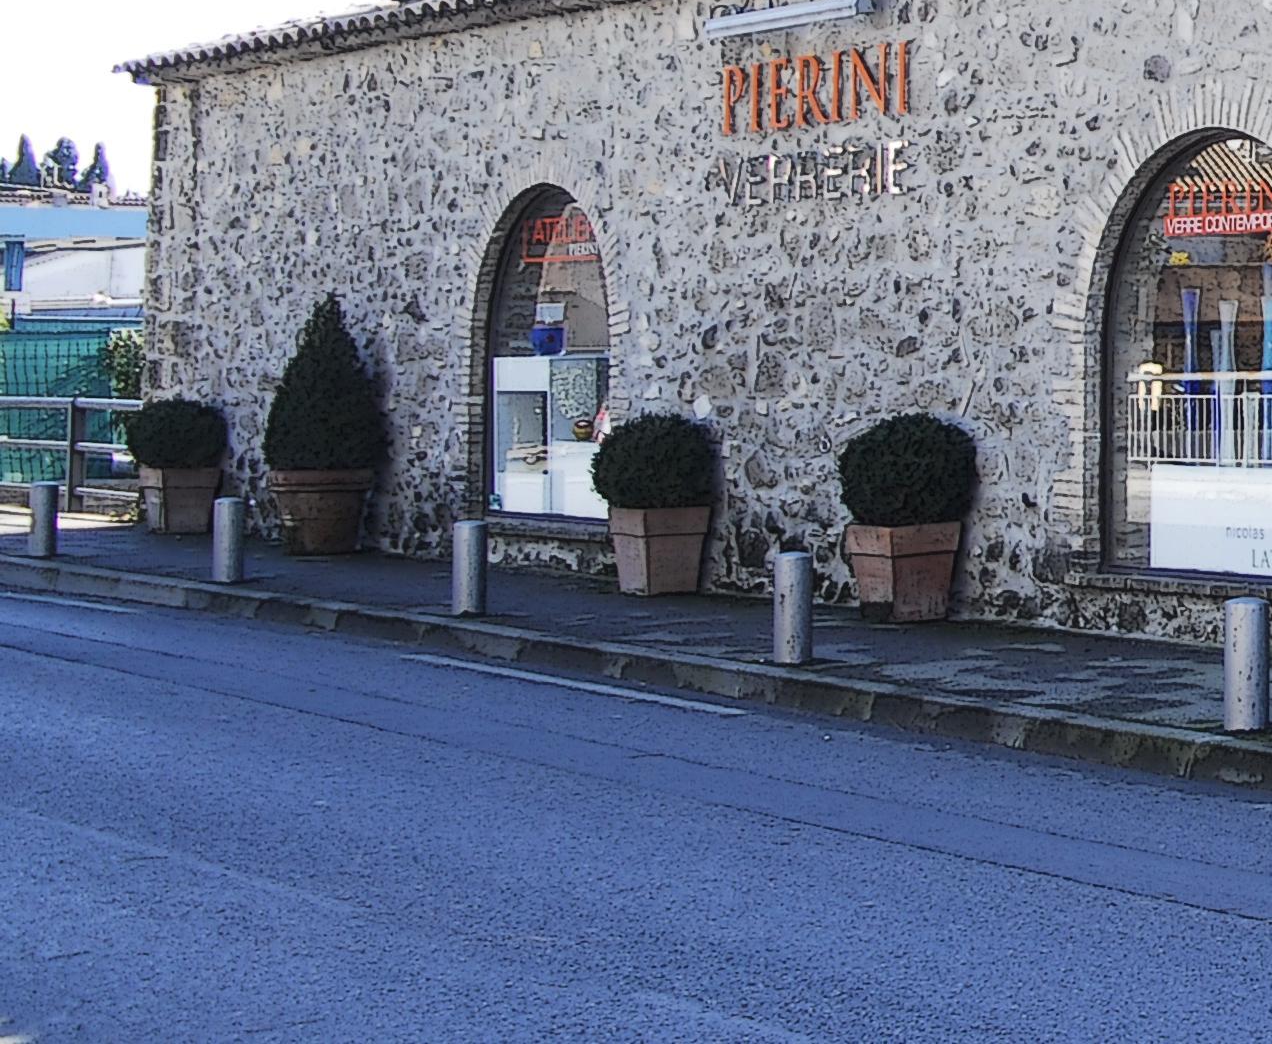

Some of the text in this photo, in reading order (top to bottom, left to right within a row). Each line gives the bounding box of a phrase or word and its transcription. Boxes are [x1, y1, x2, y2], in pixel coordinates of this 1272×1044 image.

[722, 41, 909, 136] PIERINI
[1167, 216, 1202, 234] VERRE
[1226, 525, 1265, 540] nicolas
